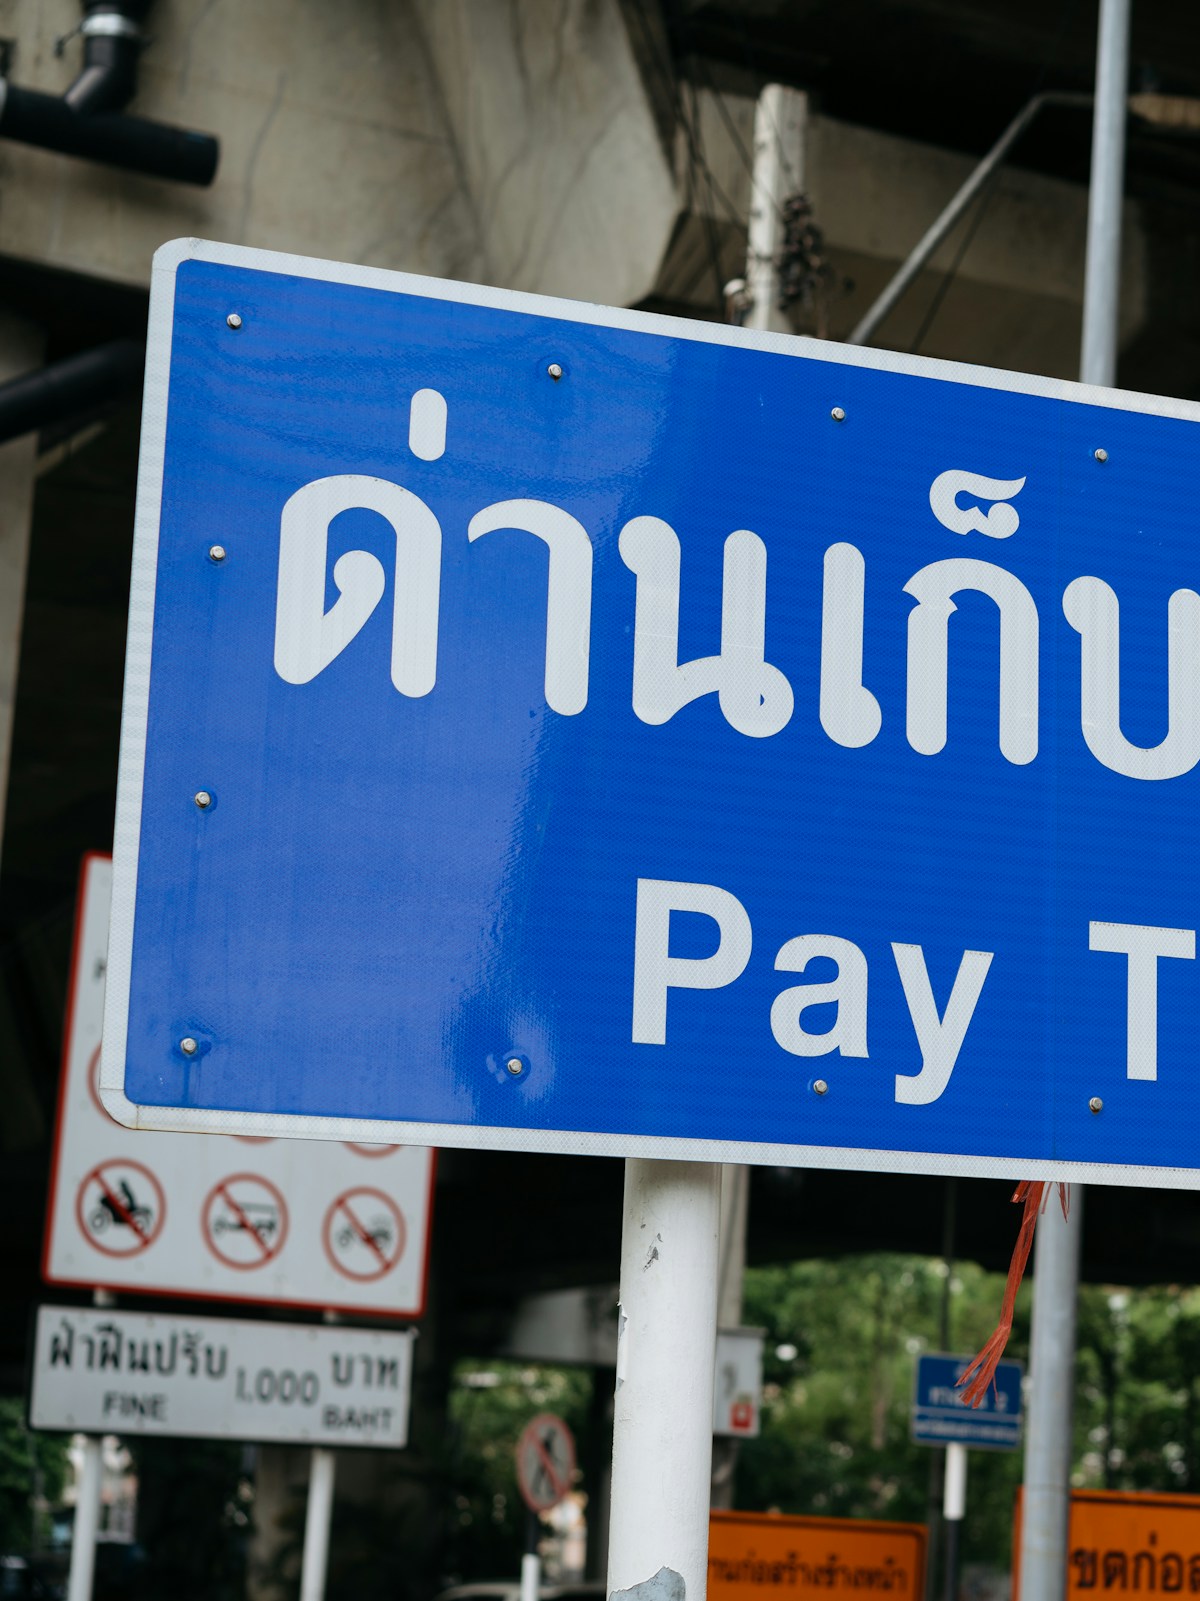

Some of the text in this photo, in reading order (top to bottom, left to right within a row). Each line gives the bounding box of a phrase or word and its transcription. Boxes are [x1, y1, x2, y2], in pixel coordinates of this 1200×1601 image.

[632, 879, 993, 1104] Pay
[331, 1351, 398, 1389] บาท
[102, 1391, 395, 1431] FINE BAHT
